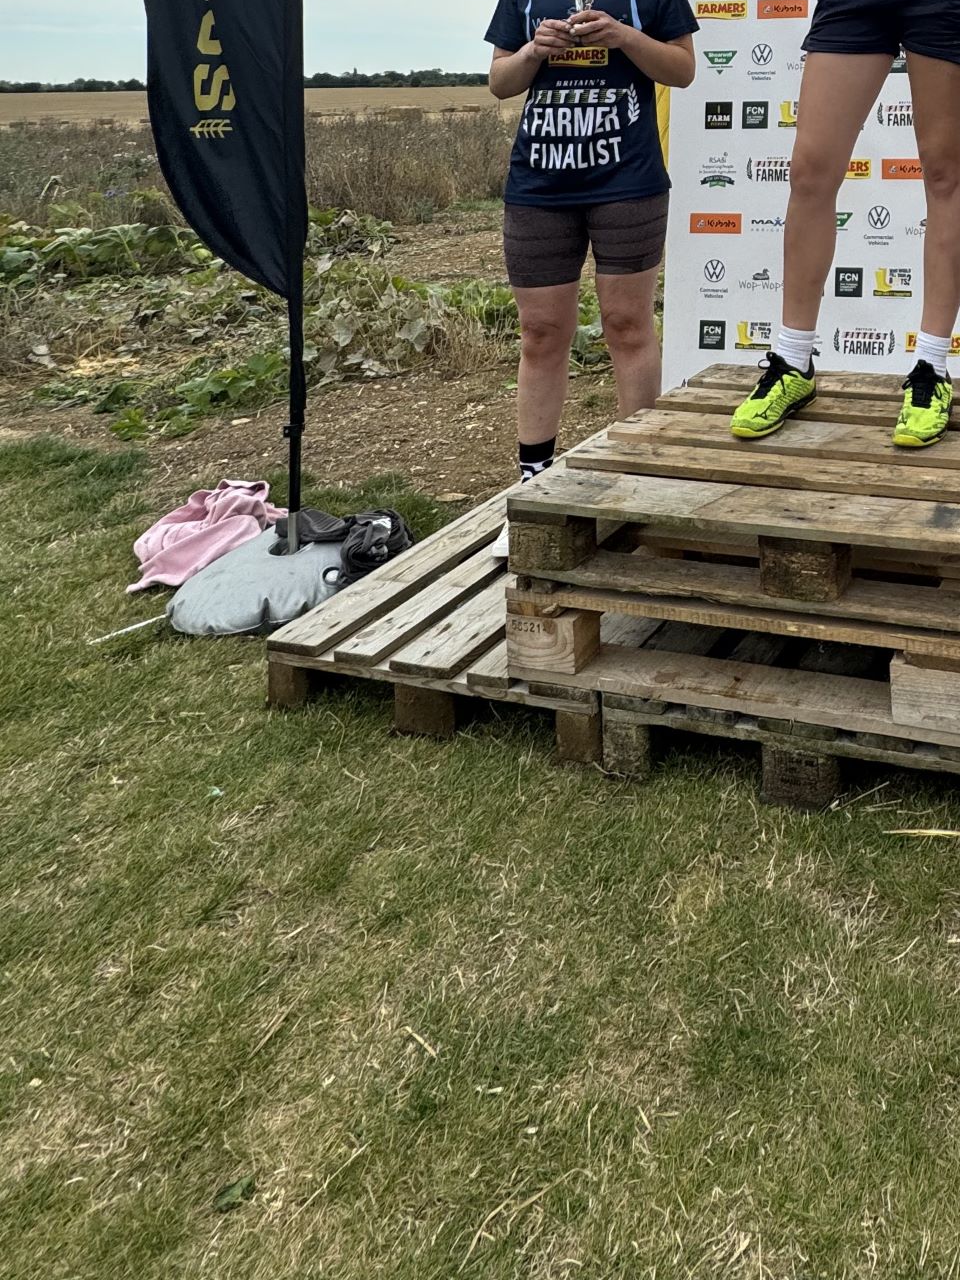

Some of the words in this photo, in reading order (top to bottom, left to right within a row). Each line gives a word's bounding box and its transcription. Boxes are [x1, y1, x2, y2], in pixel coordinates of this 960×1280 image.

[697, 3, 746, 14] FARMERS
[773, 5, 803, 13] Kubota
[556, 79, 606, 87] BRITAIN'S
[887, 113, 913, 127] FARM
[530, 137, 622, 170] FINALIST
[900, 165, 922, 173] Kubo
[756, 169, 788, 182] FARME
[707, 220, 736, 228] Kubota
[751, 217, 785, 226] MAX
[839, 273, 859, 282] FCN
[703, 326, 722, 334] FCN
[844, 331, 888, 340] FITTEST
[843, 340, 885, 356] FARMER
